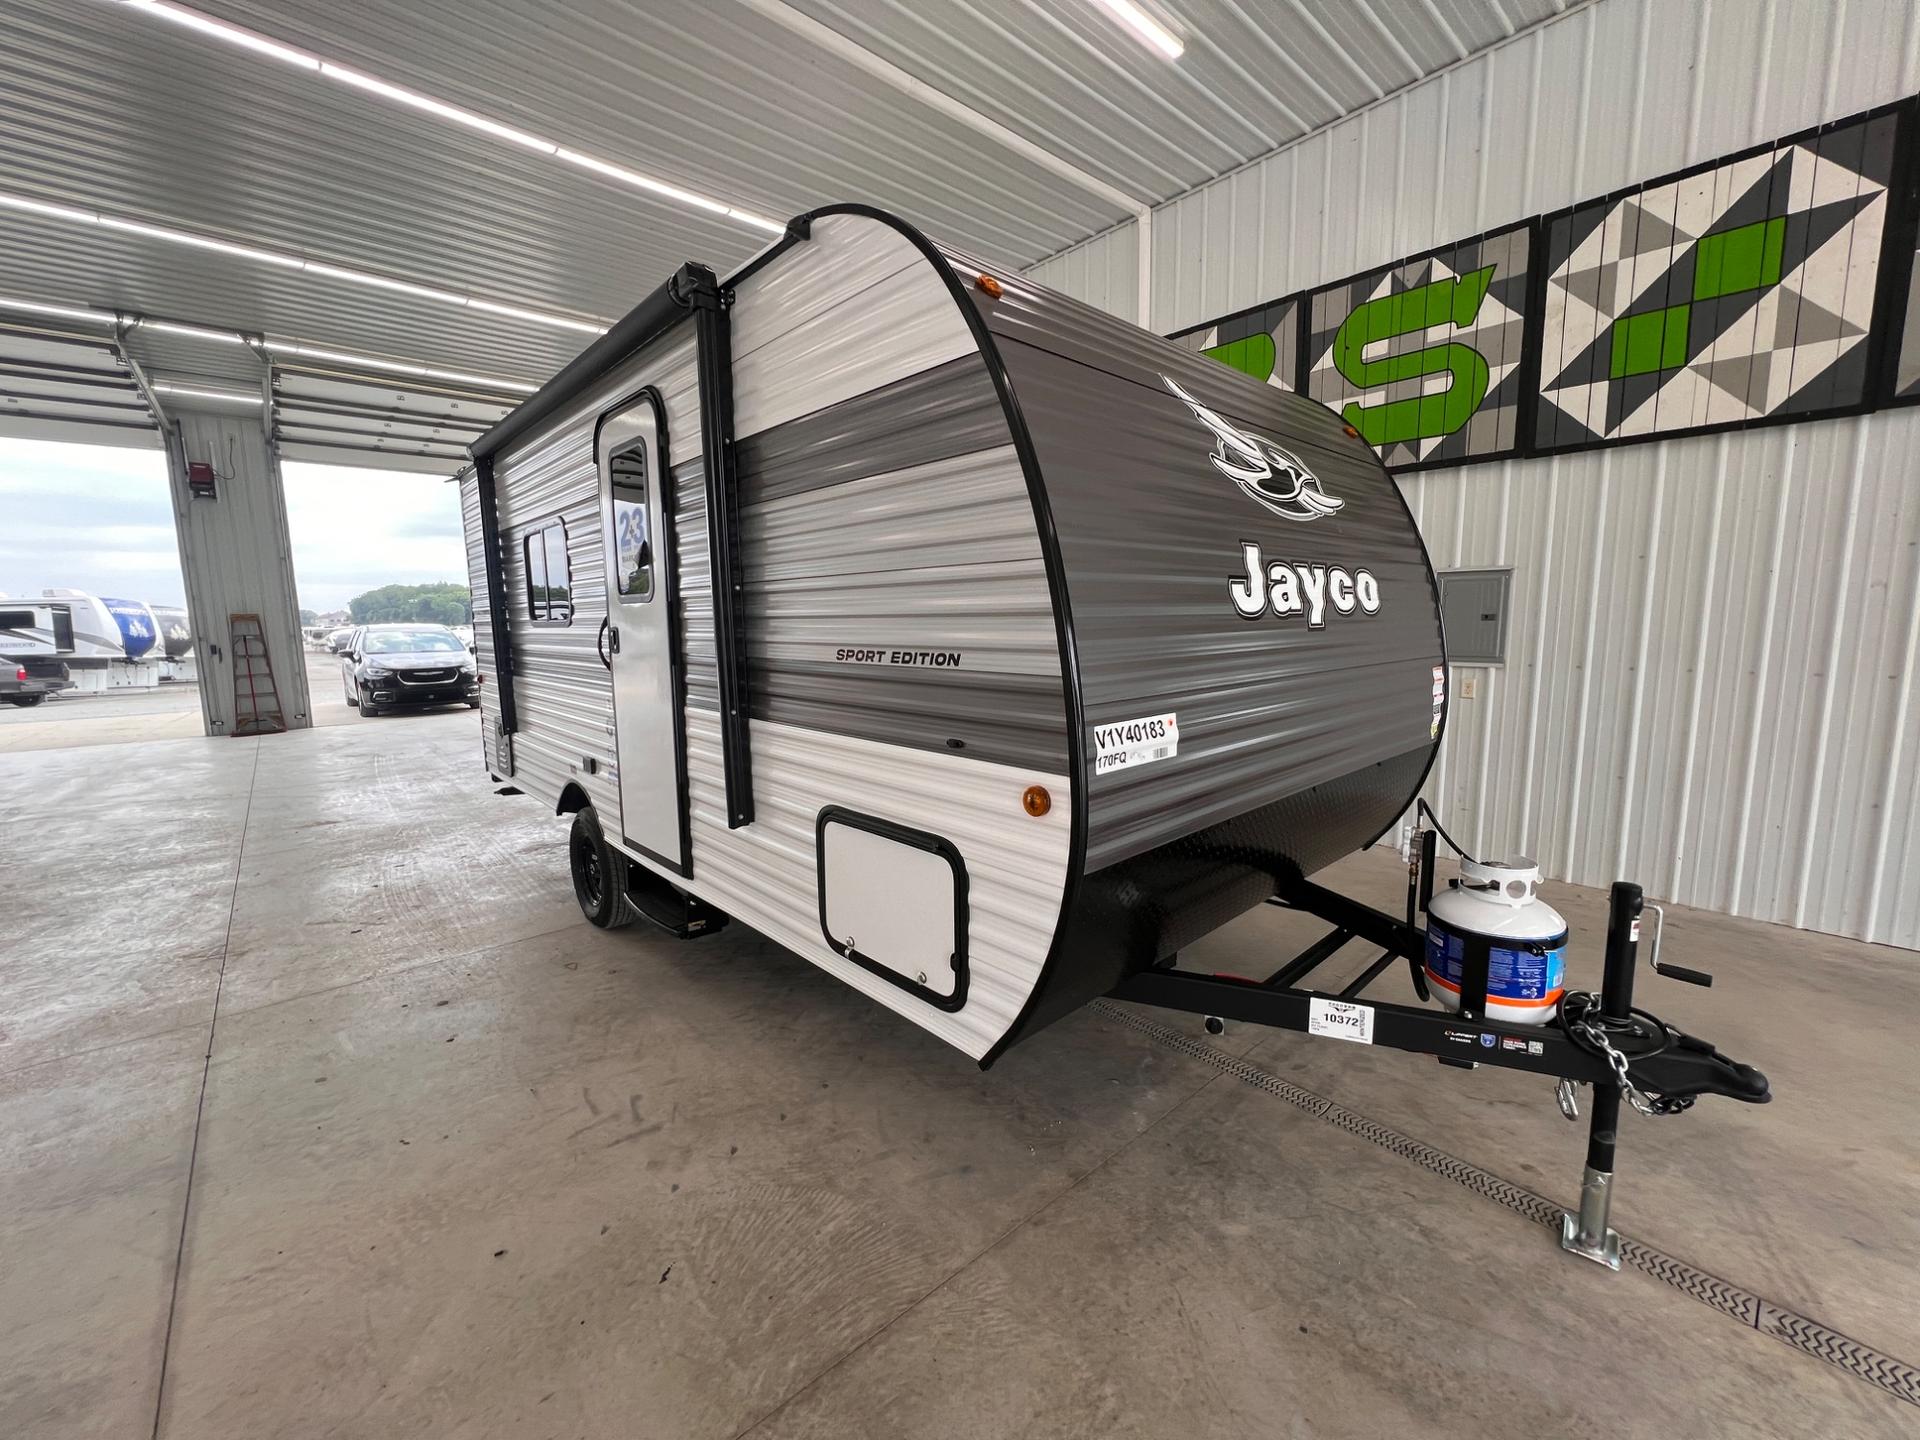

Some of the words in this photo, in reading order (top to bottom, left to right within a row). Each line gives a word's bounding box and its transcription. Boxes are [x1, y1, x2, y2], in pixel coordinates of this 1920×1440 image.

[1228, 540, 1381, 631] Jayco
[836, 649, 886, 662] SPORT
[890, 651, 961, 666] EDITION
[1095, 719, 1166, 749] V1Y40183
[1097, 751, 1127, 769] 170FQ
[1324, 1013, 1359, 1027] 10372
